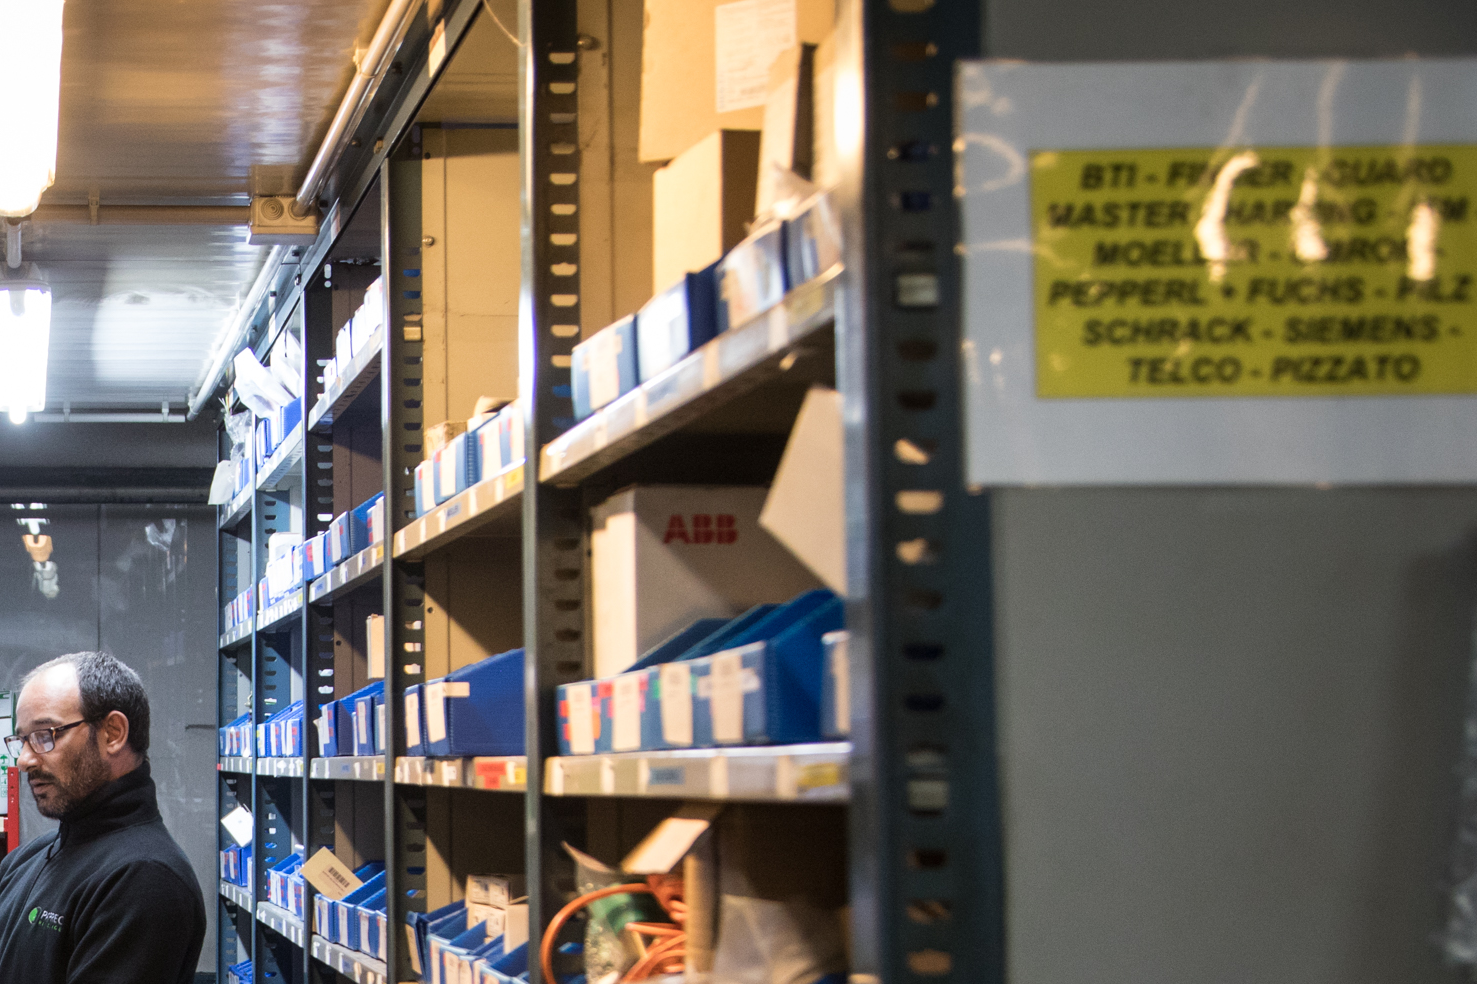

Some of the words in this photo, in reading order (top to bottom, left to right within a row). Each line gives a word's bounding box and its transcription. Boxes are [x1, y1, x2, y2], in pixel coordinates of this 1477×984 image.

[1079, 161, 1139, 191] BTI
[1165, 159, 1295, 189] FINER
[1323, 157, 1454, 187] GUARD
[1045, 200, 1192, 229] MASTER
[1224, 197, 1379, 227] HARING
[1092, 238, 1261, 268] MOELLR
[1047, 277, 1207, 308] PEPPERL
[1244, 275, 1366, 305] FUCHS
[1080, 315, 1255, 347] SCHRACK
[1282, 314, 1441, 344] SIEMENS
[1125, 355, 1243, 385] TELCO
[1269, 353, 1422, 384] PIZZATO
[664, 513, 739, 545] ABB
